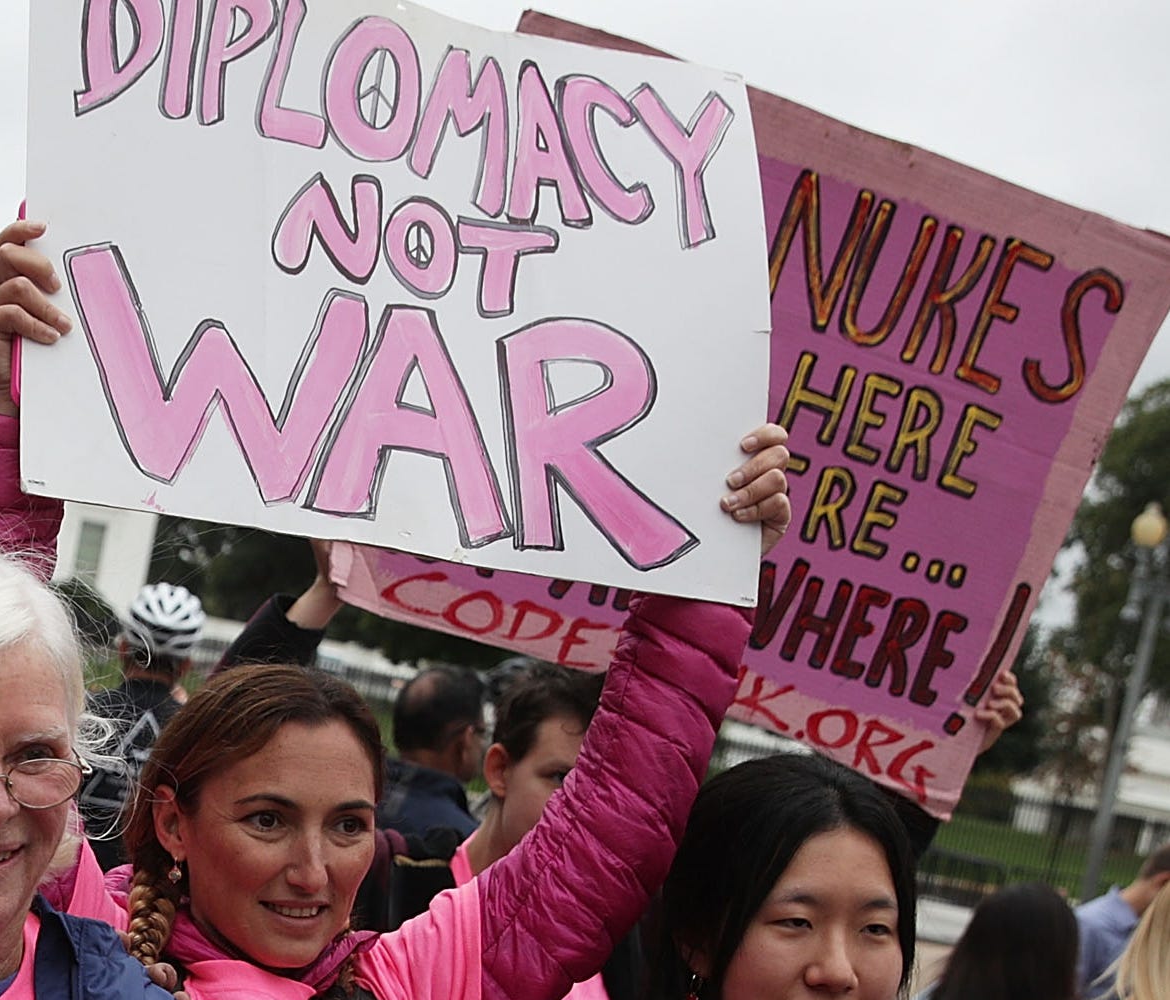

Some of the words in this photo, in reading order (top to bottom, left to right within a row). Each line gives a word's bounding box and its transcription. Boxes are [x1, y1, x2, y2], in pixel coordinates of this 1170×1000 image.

[74, 0, 735, 250] DIPLOMACY
[270, 172, 559, 318] NOT
[769, 168, 1125, 405] NUKES
[63, 241, 702, 572] WAR
[777, 350, 1003, 500] HERE
[785, 453, 968, 588] RE...
